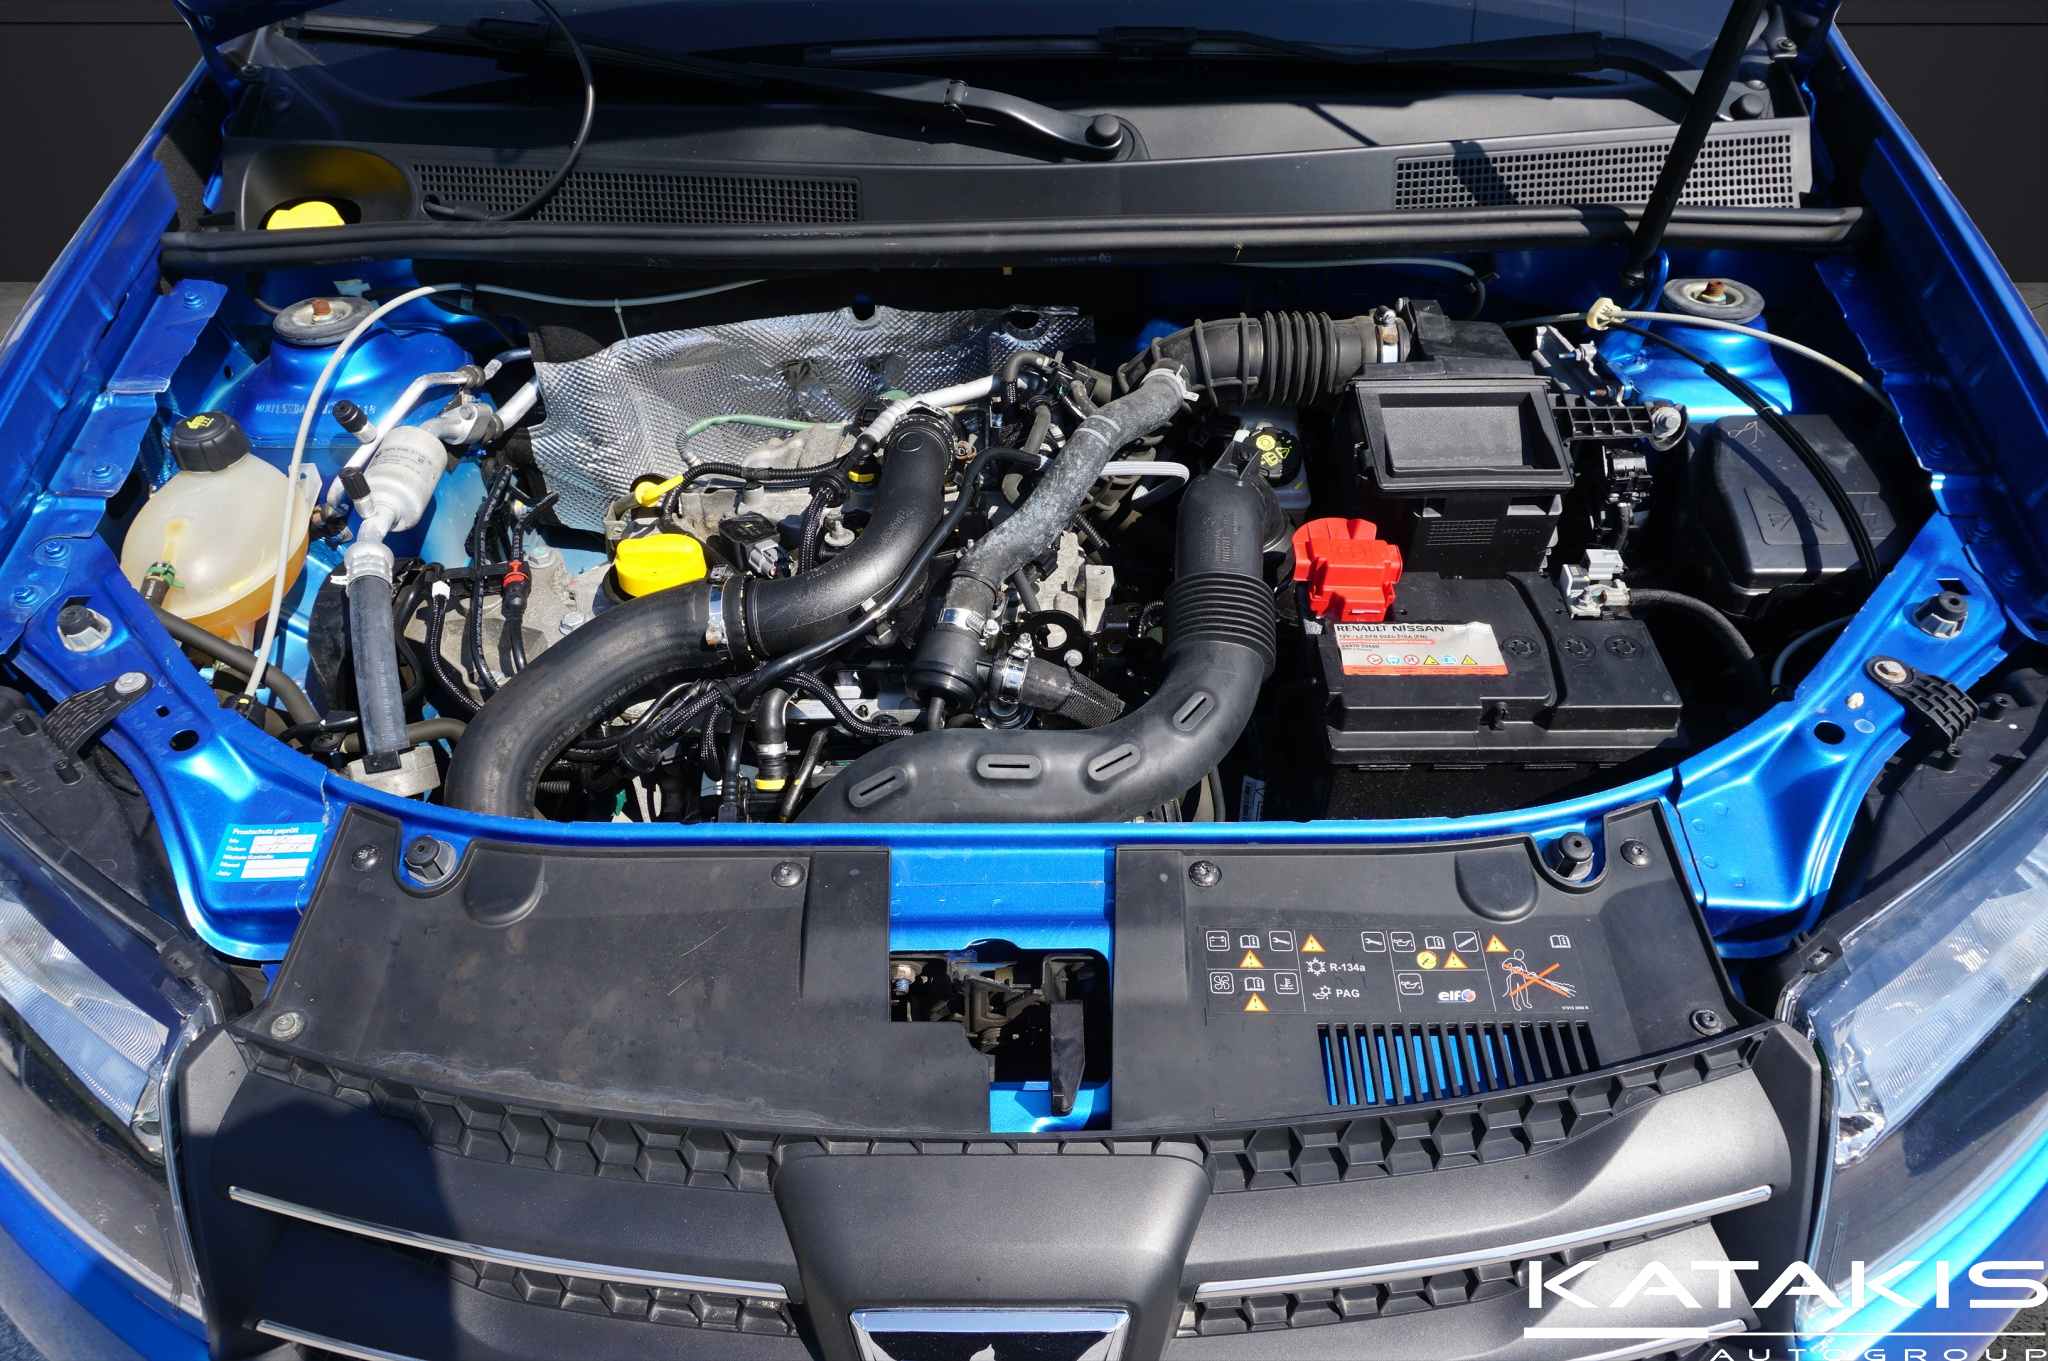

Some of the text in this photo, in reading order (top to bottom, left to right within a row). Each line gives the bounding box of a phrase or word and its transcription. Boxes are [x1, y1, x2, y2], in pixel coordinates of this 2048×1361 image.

[1392, 624, 1445, 632] NISSAN
[1329, 962, 1366, 972] R-134a
[1335, 989, 1360, 998] PAG
[1438, 990, 1461, 1000] elf
